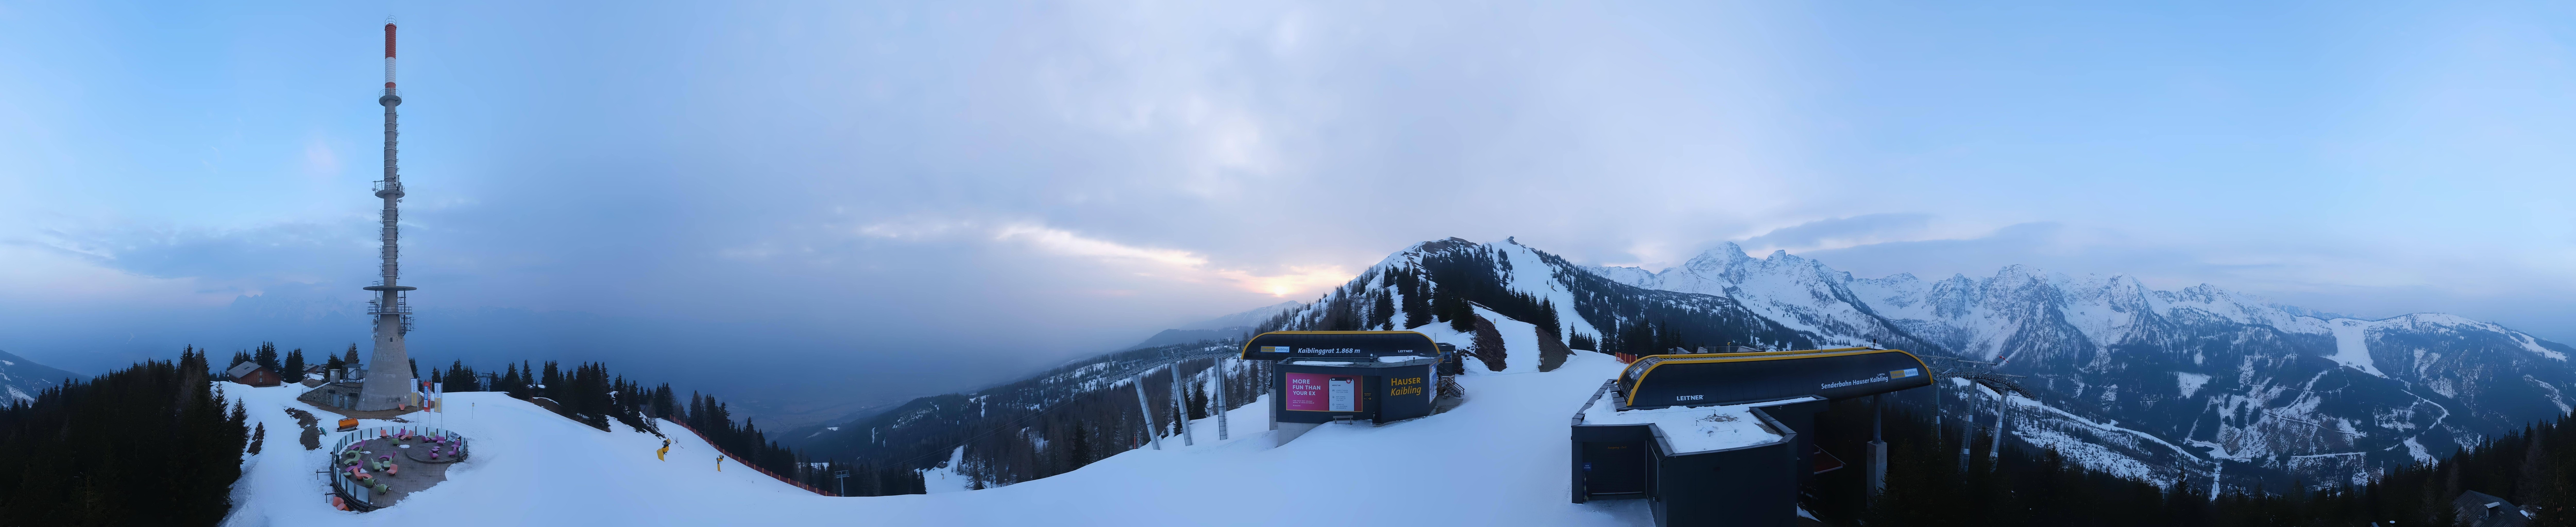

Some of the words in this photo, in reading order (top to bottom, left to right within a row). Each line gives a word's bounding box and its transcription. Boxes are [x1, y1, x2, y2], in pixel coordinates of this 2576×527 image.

[1391, 377, 1421, 386] HAUSER
[1821, 380, 1851, 389] Senderbahn
[1391, 386, 1421, 396] Kaibling
